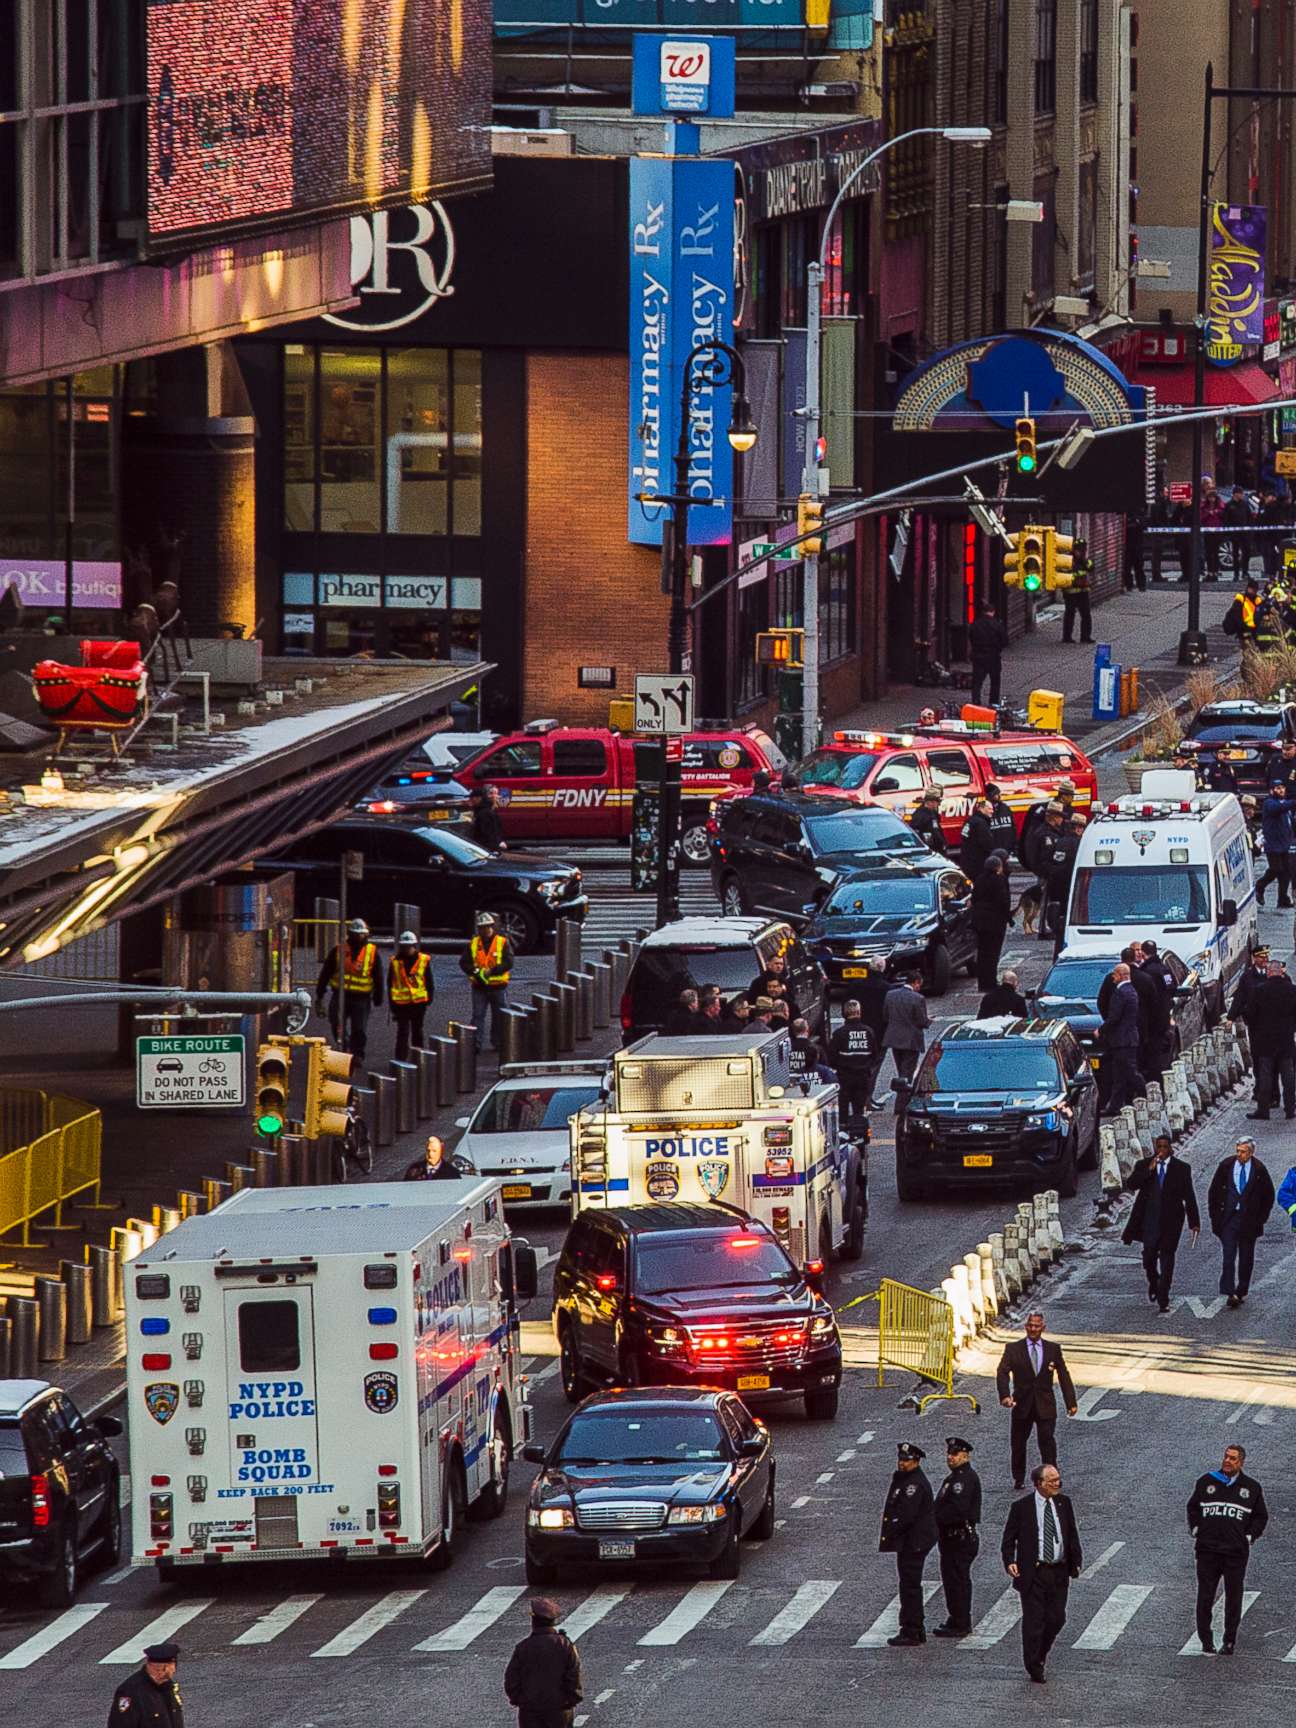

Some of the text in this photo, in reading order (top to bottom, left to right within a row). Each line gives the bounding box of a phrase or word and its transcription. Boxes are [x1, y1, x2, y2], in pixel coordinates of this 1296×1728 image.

[634, 201, 665, 257] Rx
[681, 202, 719, 257] Rx
[634, 271, 669, 508] pharmacy
[322, 577, 443, 606] pharmacy
[637, 719, 662, 729] ONLY
[552, 788, 607, 808] FDNY
[938, 797, 978, 818] FDNY
[1099, 837, 1121, 845] NYPD
[1166, 836, 1189, 844] NYPD
[848, 1031, 867, 1040] STATE
[151, 1039, 230, 1052] BIKE ROUTE
[848, 1039, 868, 1049] POLICE
[154, 1076, 228, 1087] DO NOT PASS
[144, 1089, 238, 1101] IN SHARED LANE
[645, 1137, 729, 1158] POLICE
[766, 1147, 792, 1156] 53952
[648, 1163, 676, 1173] POLICE
[366, 1373, 396, 1384] POLICE
[239, 1382, 304, 1400] NYPD
[229, 1400, 315, 1419] POLICE
[243, 1449, 306, 1465] BOMB
[238, 1464, 312, 1482] SQUAD
[217, 1484, 334, 1498] KEEP BACK 200 FEET
[1202, 1505, 1245, 1520] POLICE
[329, 1521, 353, 1531] 7092
